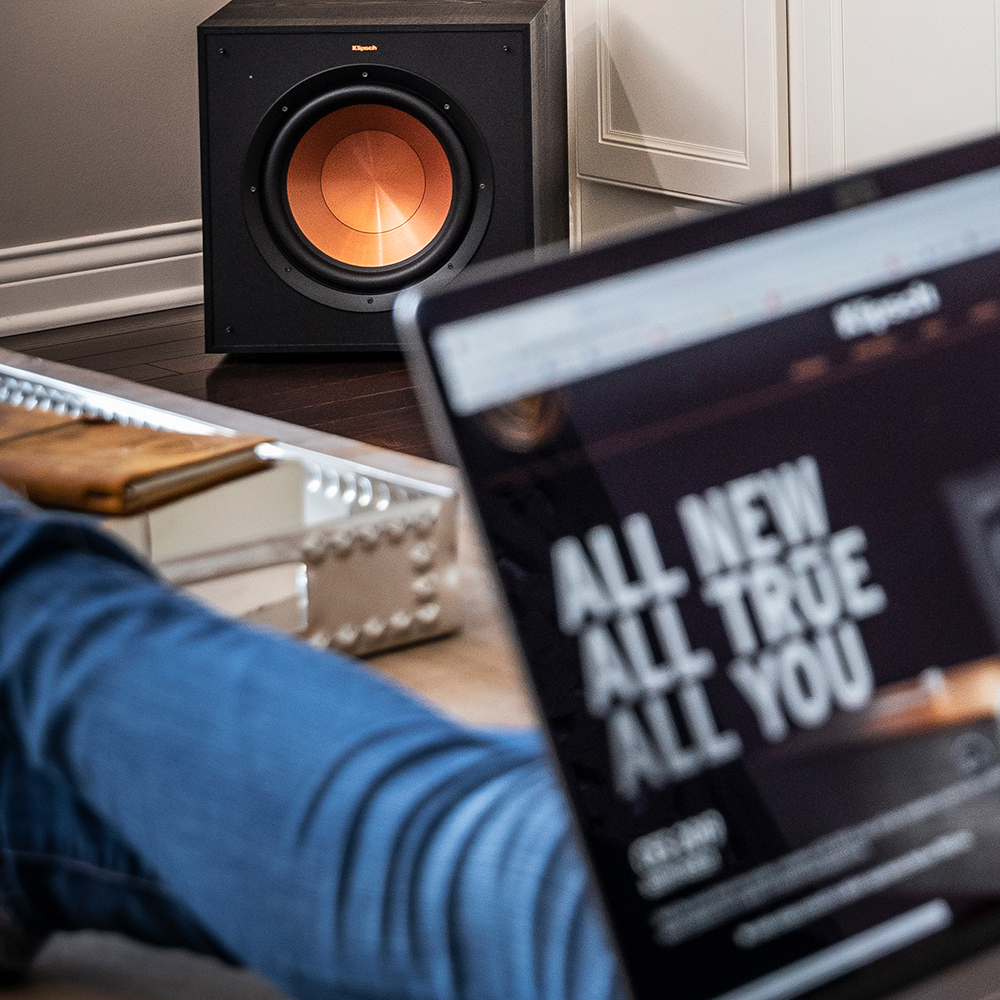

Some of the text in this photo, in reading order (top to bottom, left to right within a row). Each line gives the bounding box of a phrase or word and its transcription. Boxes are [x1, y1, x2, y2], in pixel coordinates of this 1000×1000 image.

[351, 44, 378, 52] Klipsch
[549, 455, 831, 636] ALL NEW
[578, 525, 888, 718] ALL TRUE
[606, 682, 744, 802] ALL
[727, 621, 875, 744] YOU
